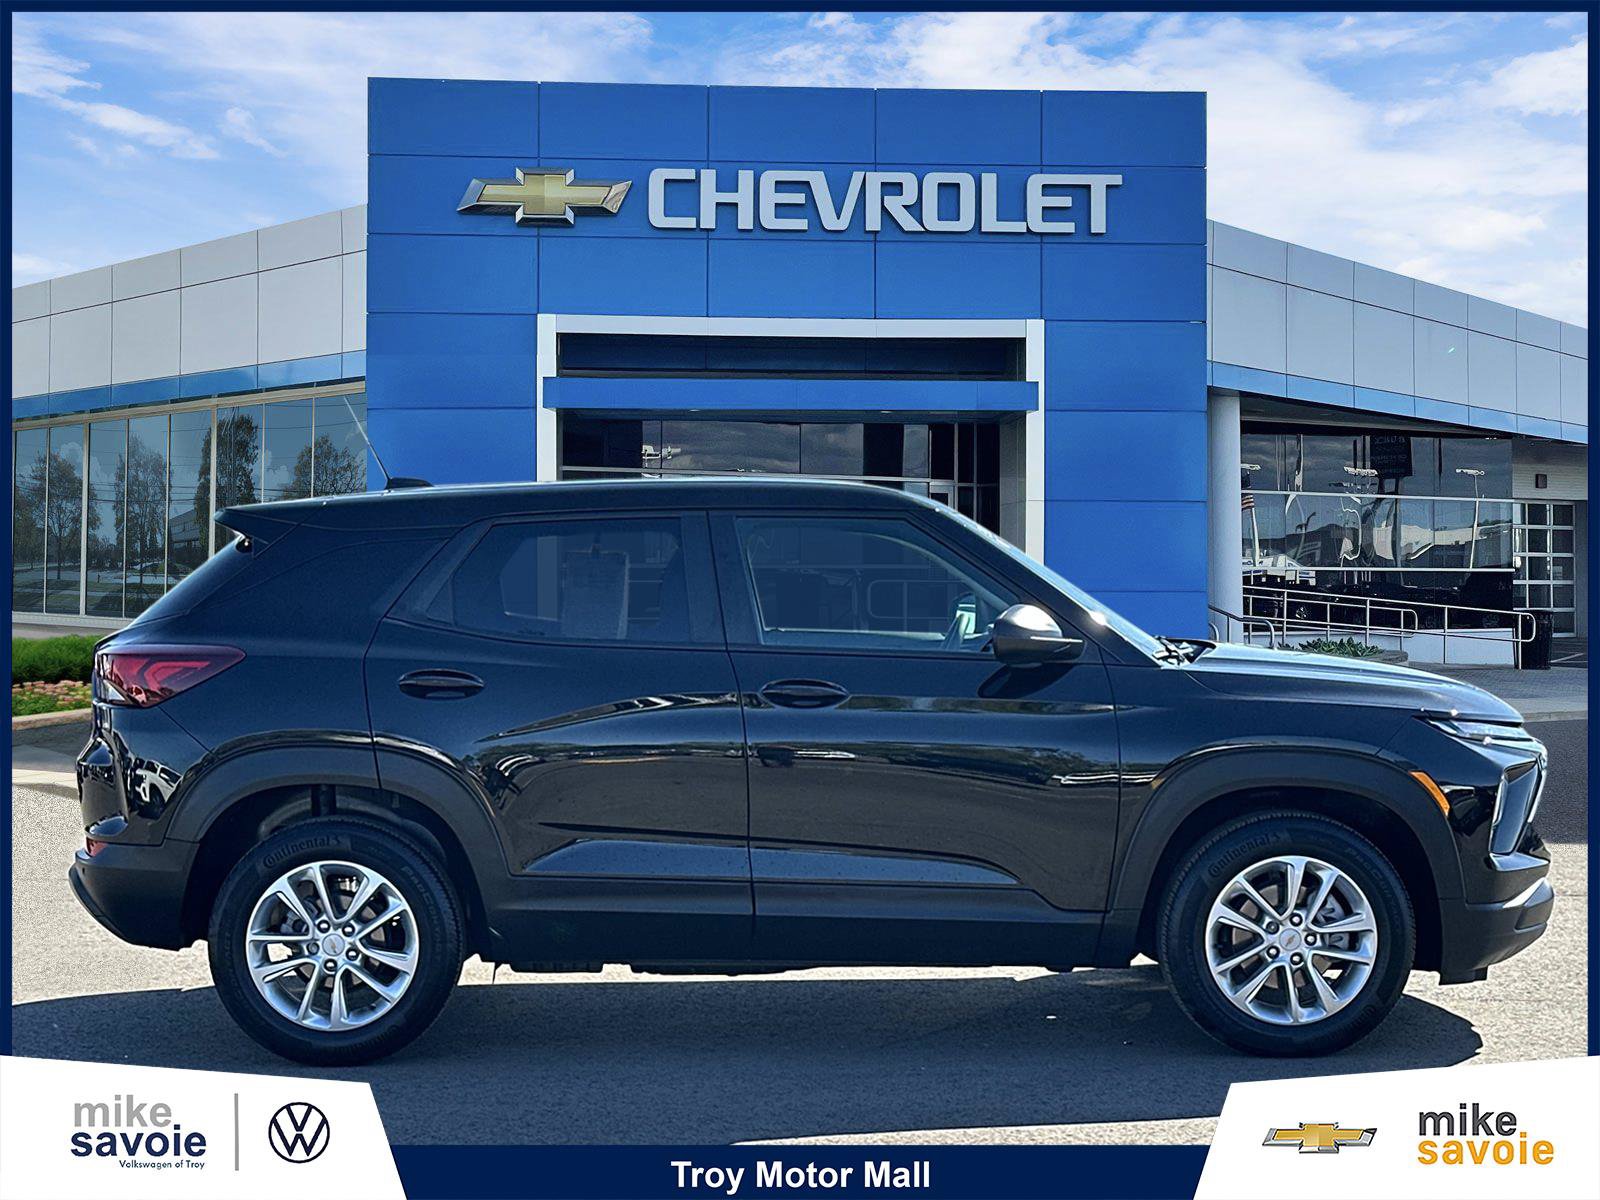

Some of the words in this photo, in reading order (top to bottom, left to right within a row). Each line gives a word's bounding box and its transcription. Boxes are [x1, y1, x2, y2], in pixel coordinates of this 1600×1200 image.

[649, 169, 1122, 232] CHEVROLET
[263, 835, 331, 868] Continental
[1207, 834, 1272, 879] Continental
